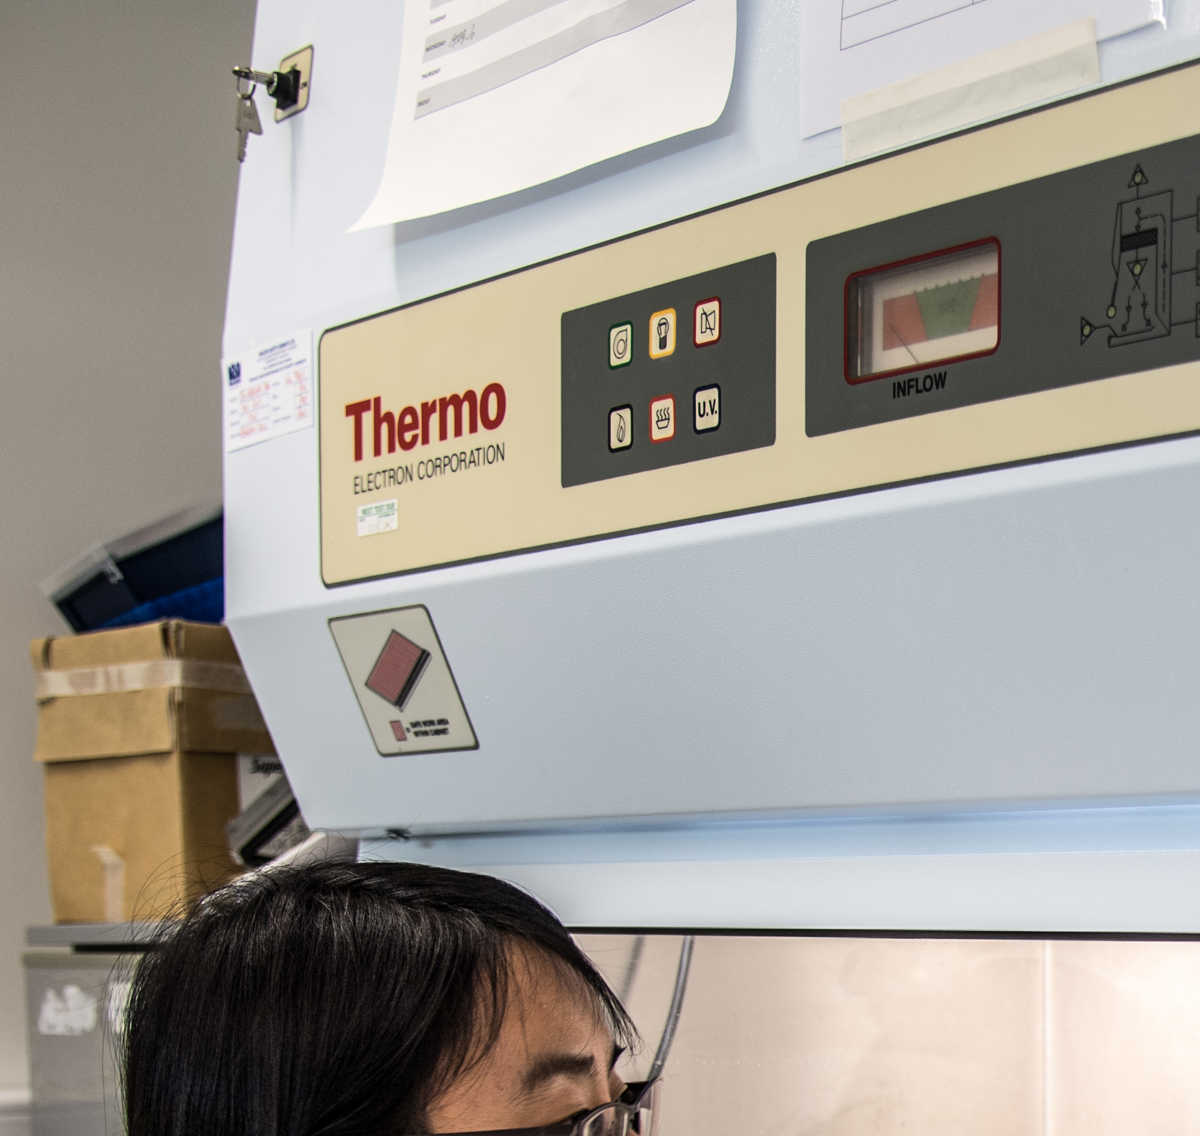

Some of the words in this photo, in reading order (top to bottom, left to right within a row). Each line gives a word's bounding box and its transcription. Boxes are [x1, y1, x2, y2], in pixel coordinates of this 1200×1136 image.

[892, 372, 948, 399] INFLOW
[345, 382, 507, 462] Thermo
[697, 399, 718, 418] U.V.
[353, 463, 414, 495] ELECTRON
[417, 442, 505, 480] CORPORATION
